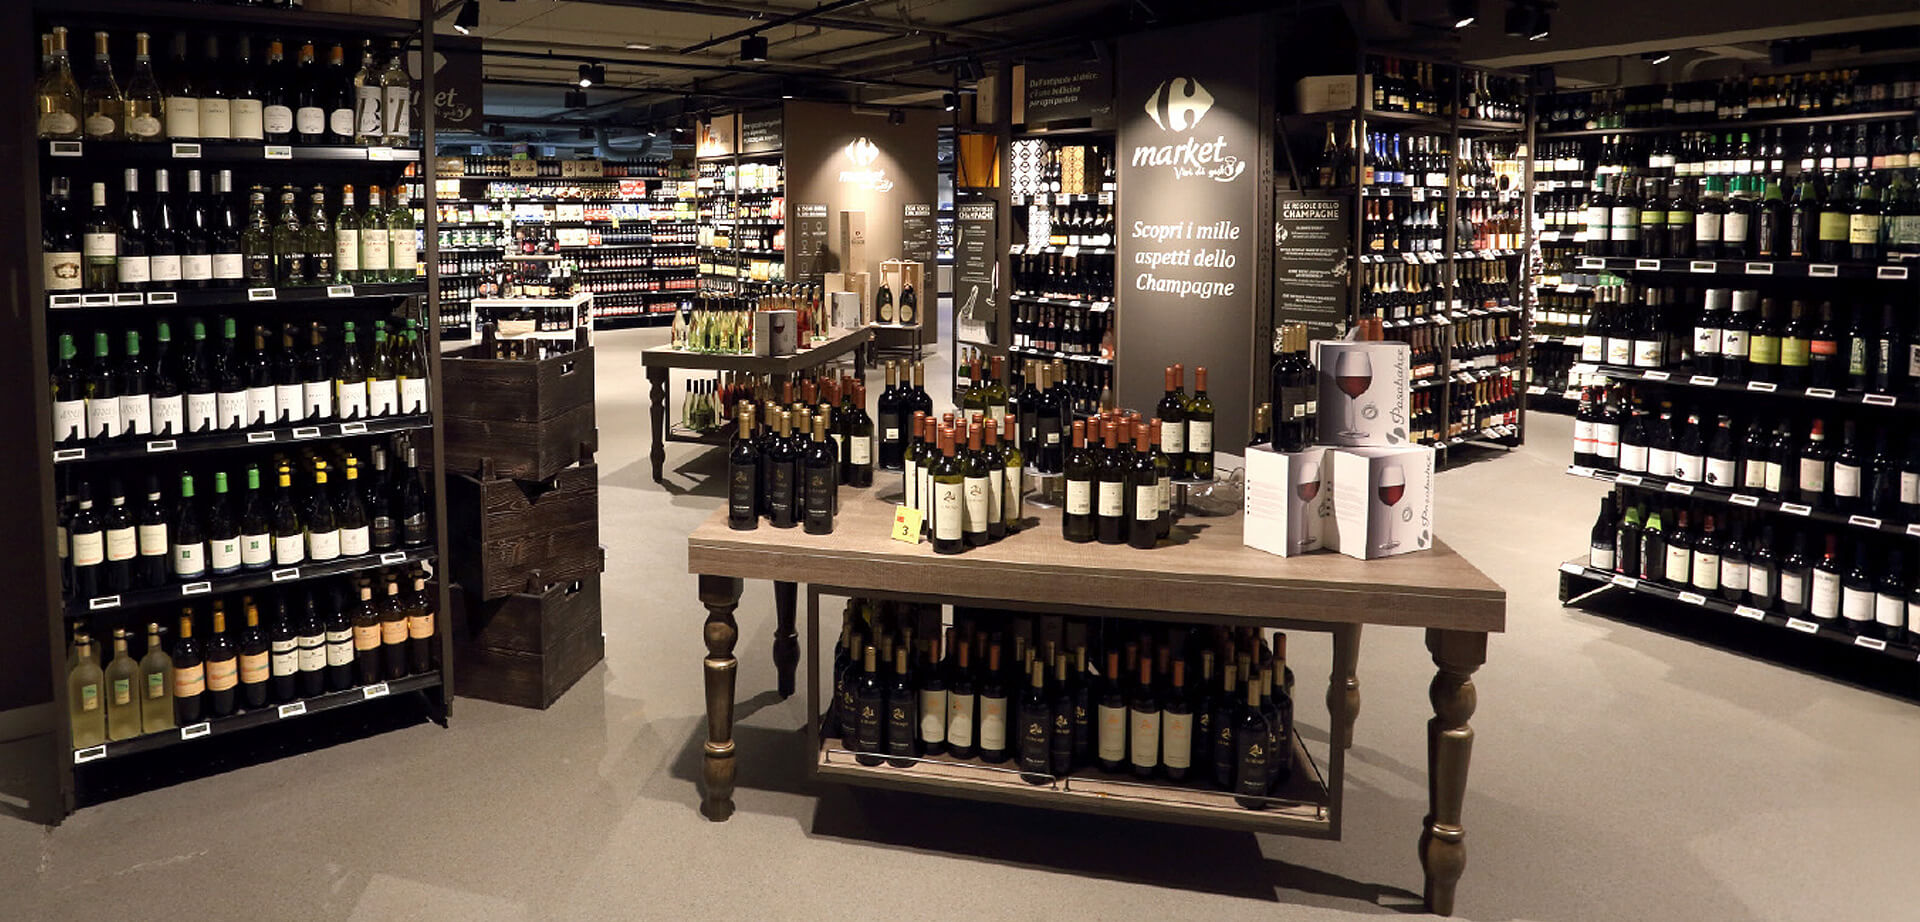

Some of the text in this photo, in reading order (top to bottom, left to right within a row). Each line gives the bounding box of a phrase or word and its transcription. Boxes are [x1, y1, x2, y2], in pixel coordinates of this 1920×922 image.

[1131, 135, 1227, 168] market
[1283, 209, 1340, 218] CHAMPAGNE
[1131, 220, 1240, 243] Scopri i mille
[1135, 248, 1236, 270] aspetti dello
[1135, 272, 1235, 299] Champagne
